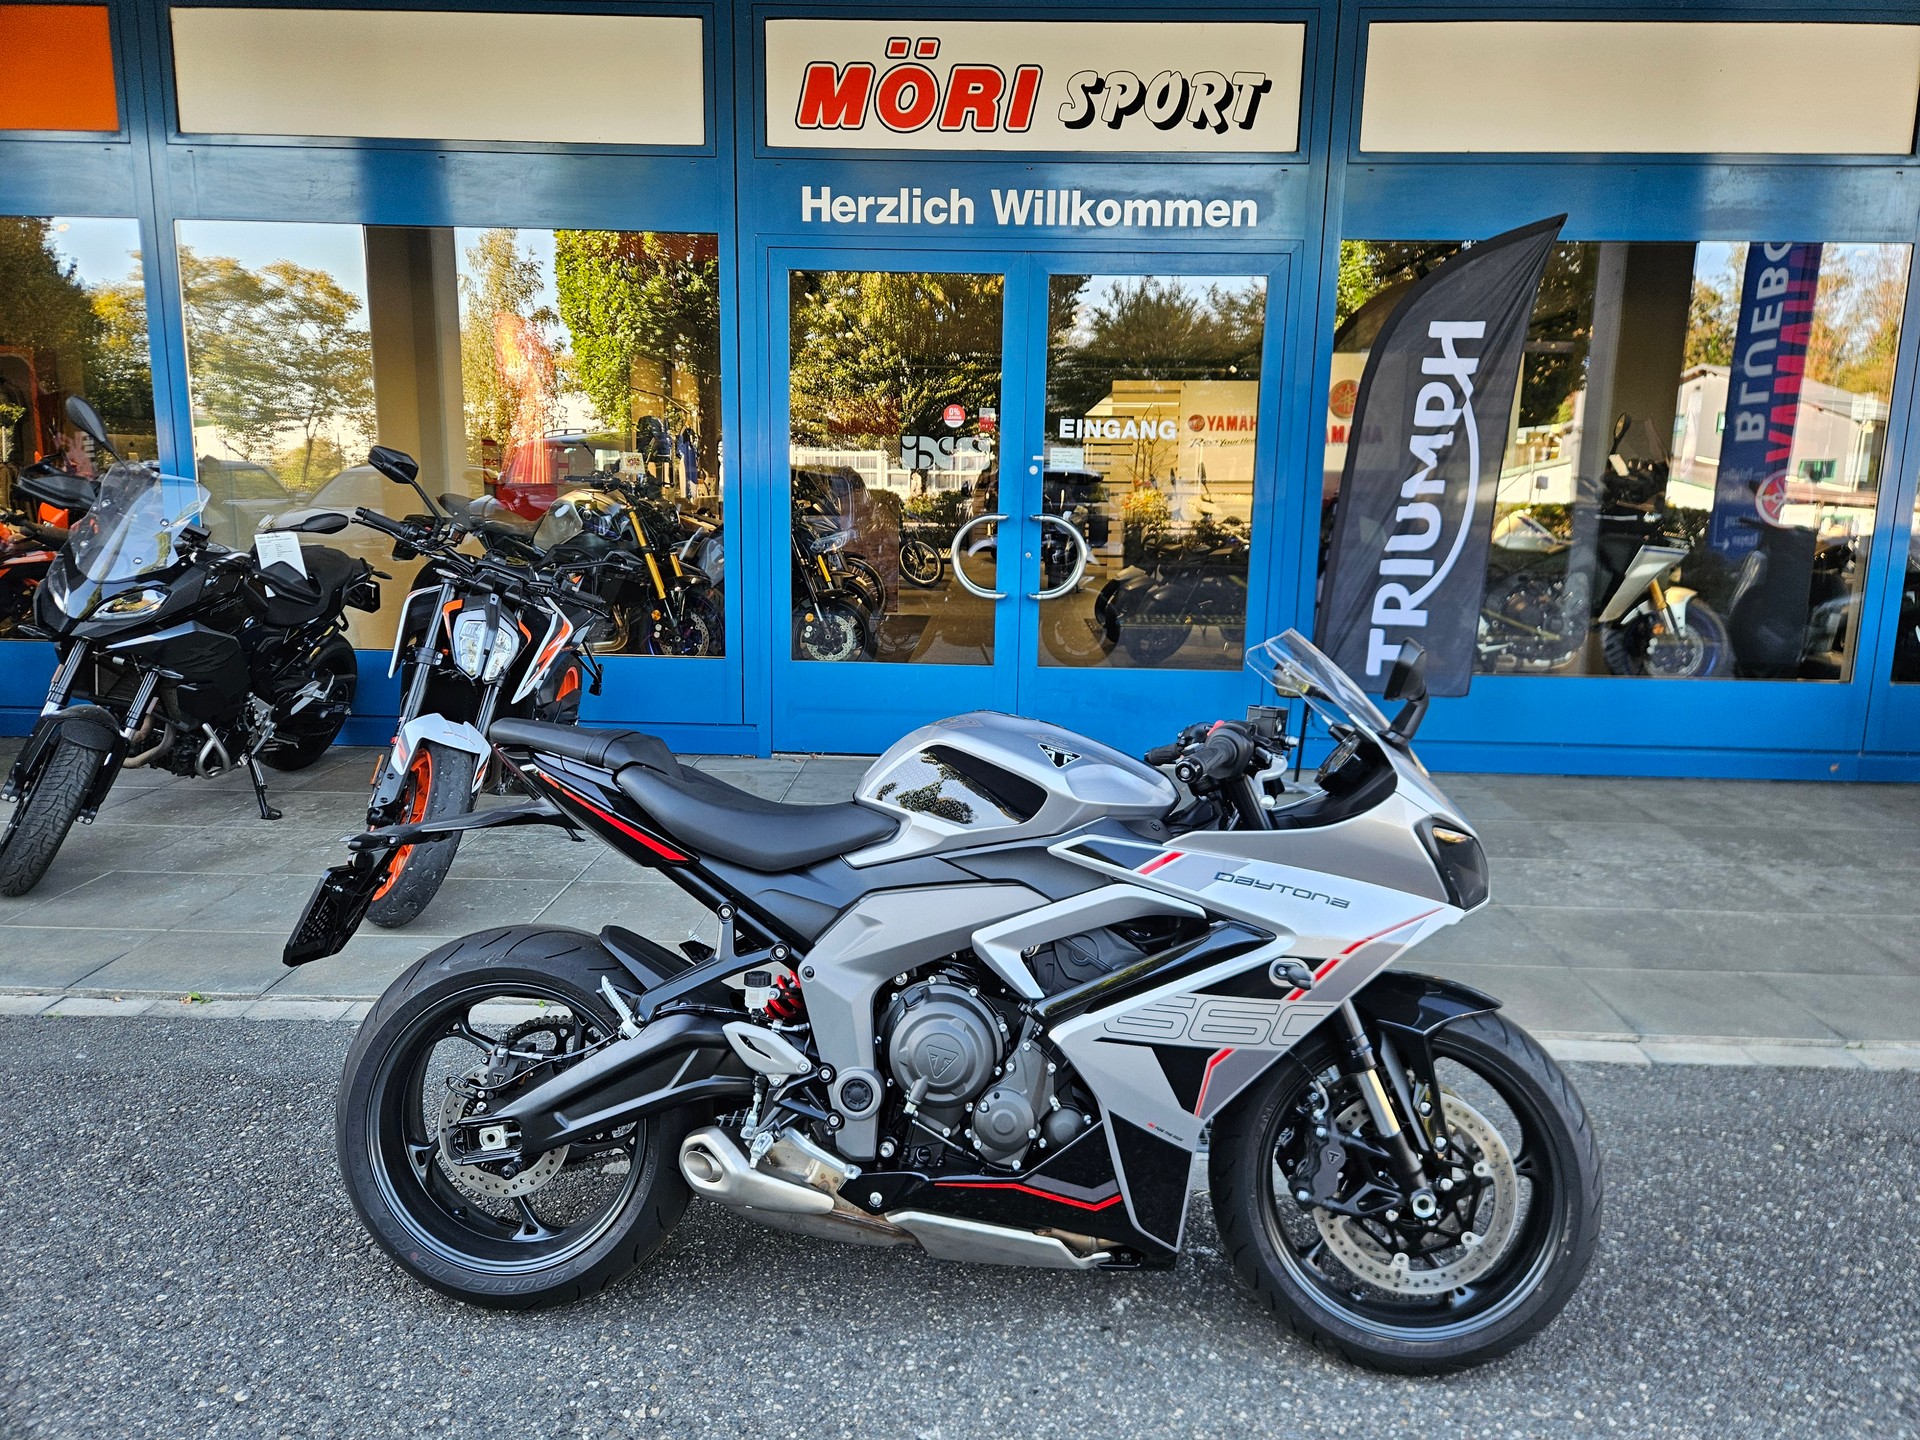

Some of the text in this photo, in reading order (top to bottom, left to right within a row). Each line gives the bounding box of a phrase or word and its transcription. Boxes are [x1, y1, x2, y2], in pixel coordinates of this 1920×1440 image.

[795, 37, 1272, 135] MÖRI SPORT
[801, 186, 1258, 227] Herzlich Willkommen
[948, 407, 961, 416] 0%
[1059, 418, 1176, 440] EINGANG
[1365, 321, 1486, 676] TRIUMPH
